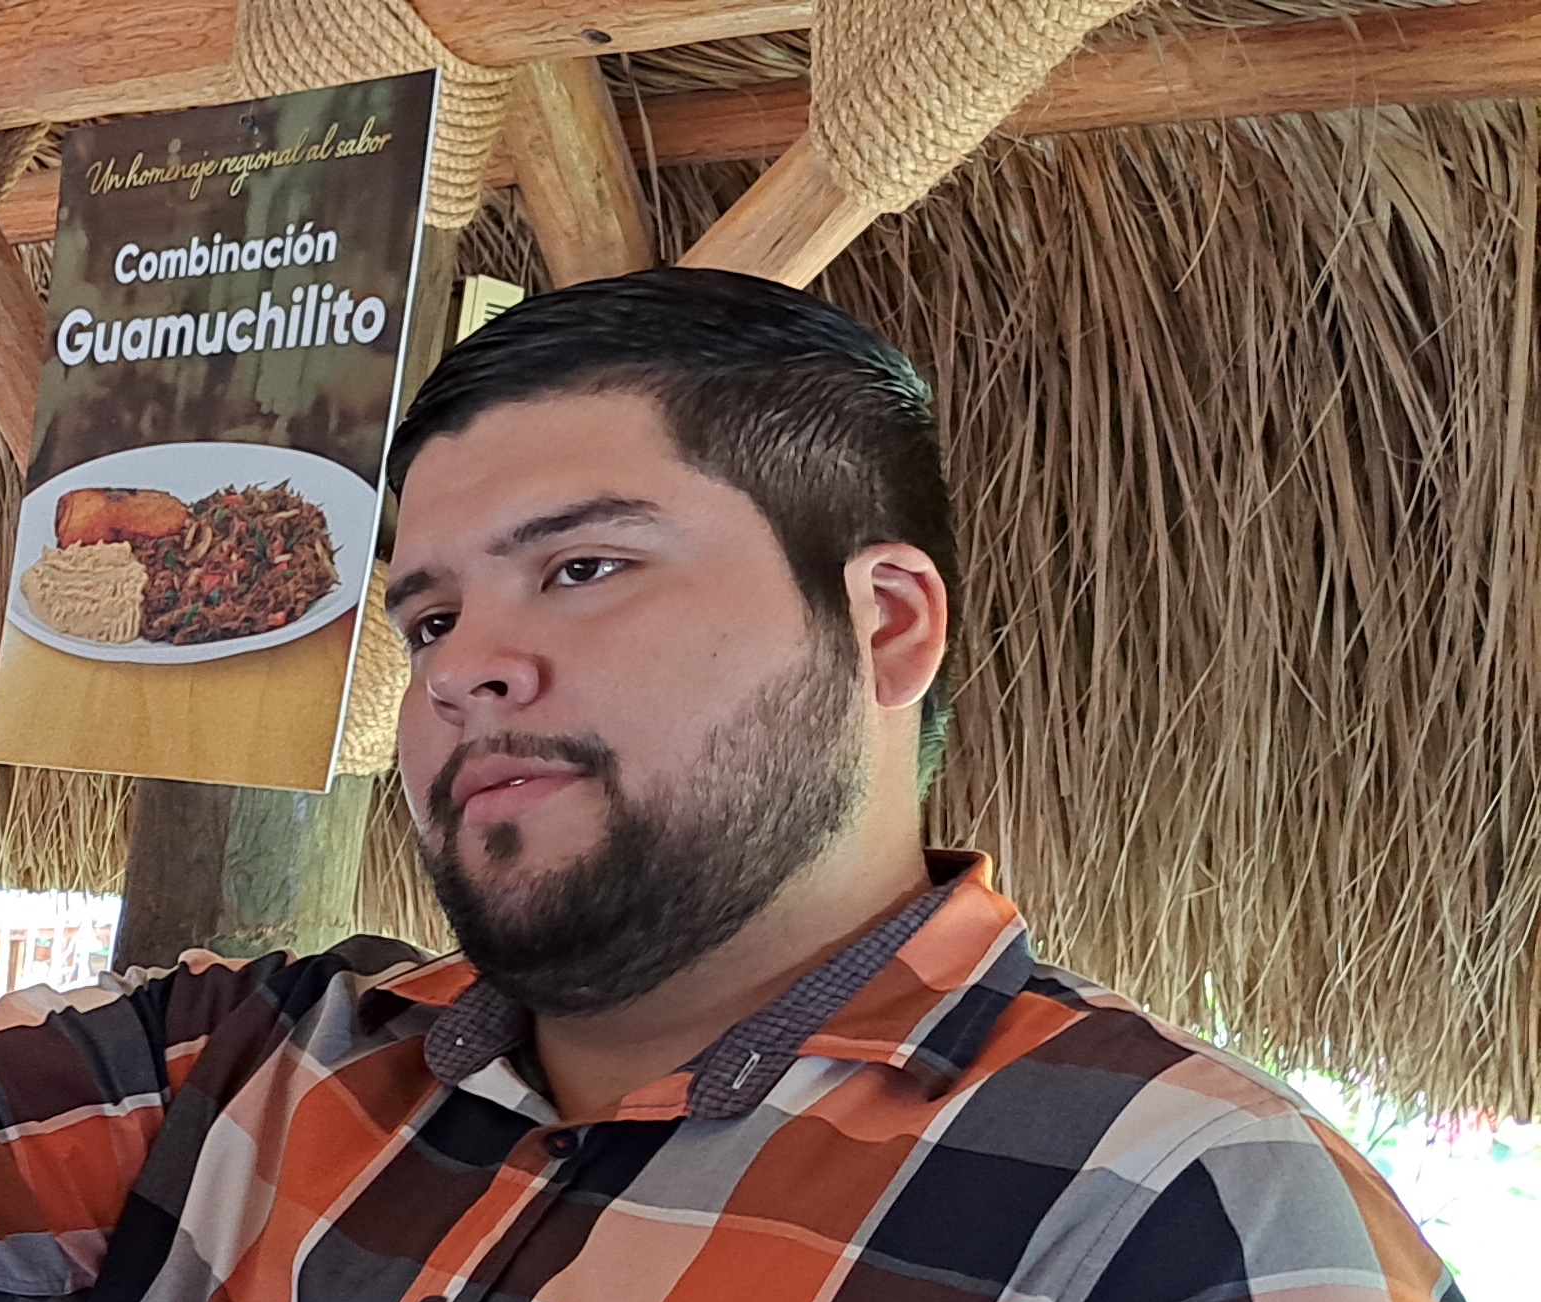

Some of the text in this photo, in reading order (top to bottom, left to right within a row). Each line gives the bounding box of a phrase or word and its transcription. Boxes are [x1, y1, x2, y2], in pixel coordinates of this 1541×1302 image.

[87, 115, 393, 200] Un homenaje regional al sabor
[115, 221, 338, 284] Combinación
[56, 283, 387, 366] Guamuchilito
